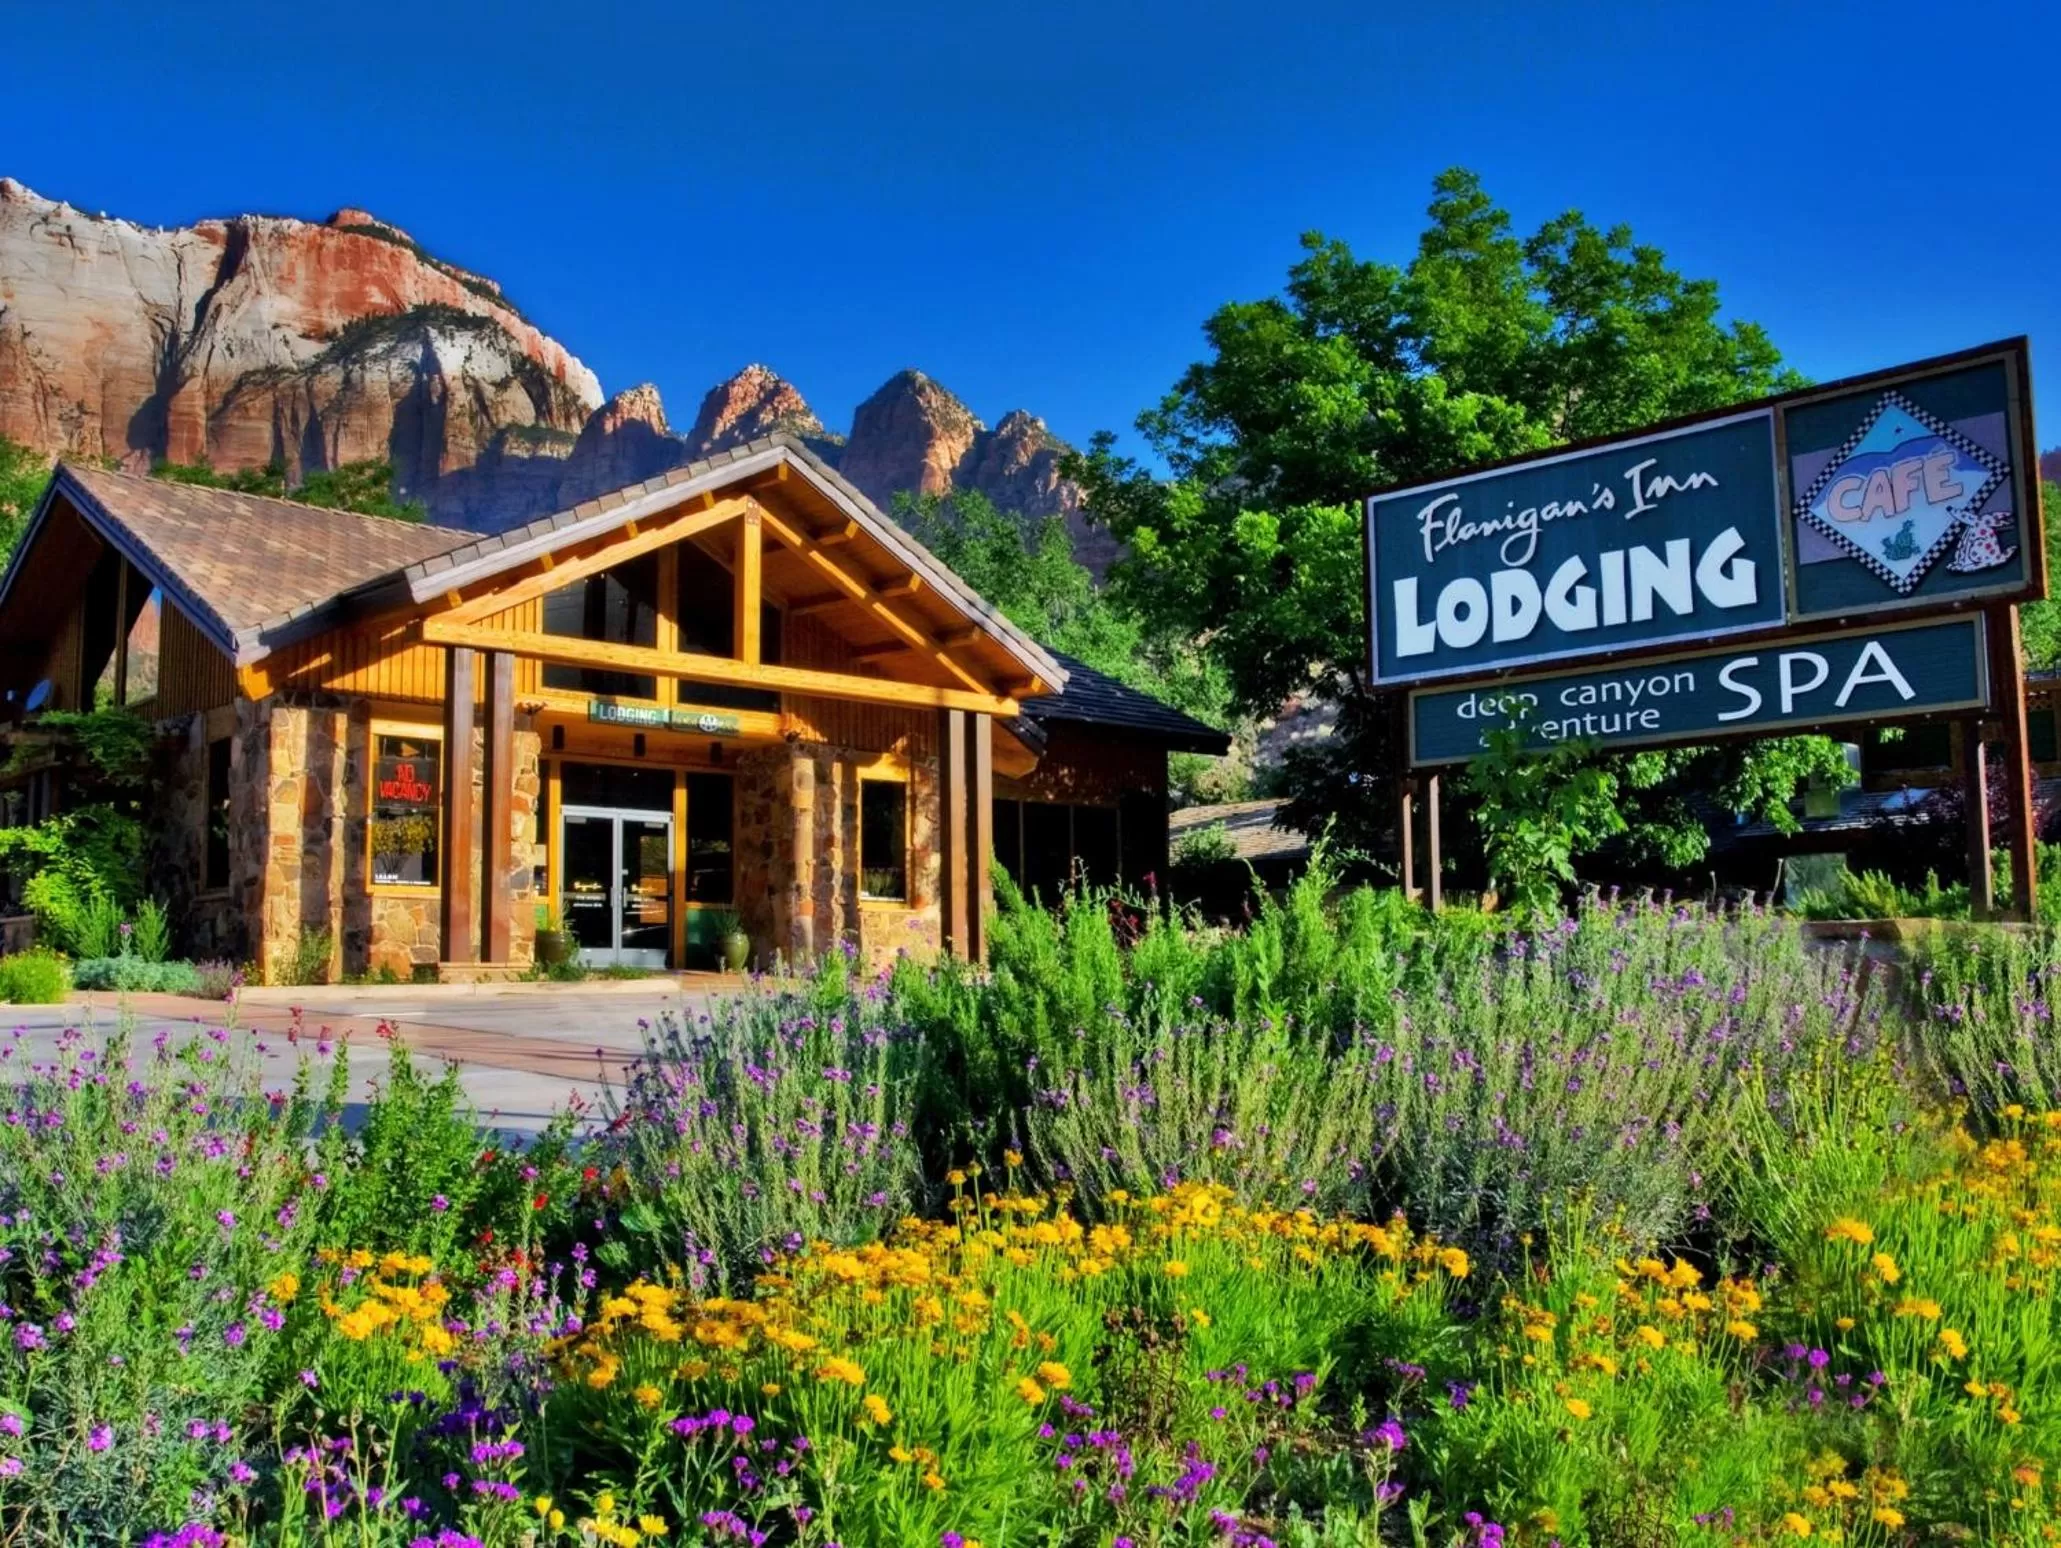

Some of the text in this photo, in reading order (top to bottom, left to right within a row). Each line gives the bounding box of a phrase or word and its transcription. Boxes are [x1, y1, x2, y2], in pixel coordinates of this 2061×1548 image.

[1417, 458, 1719, 567] Flanigan's Inn
[1393, 526, 1757, 657] LODGING
[1560, 672, 1696, 707] canyon
[1718, 641, 1916, 721] SPA
[599, 703, 657, 725] LODGING
[1479, 708, 1660, 747] enture
[380, 780, 431, 801] VACANCY
